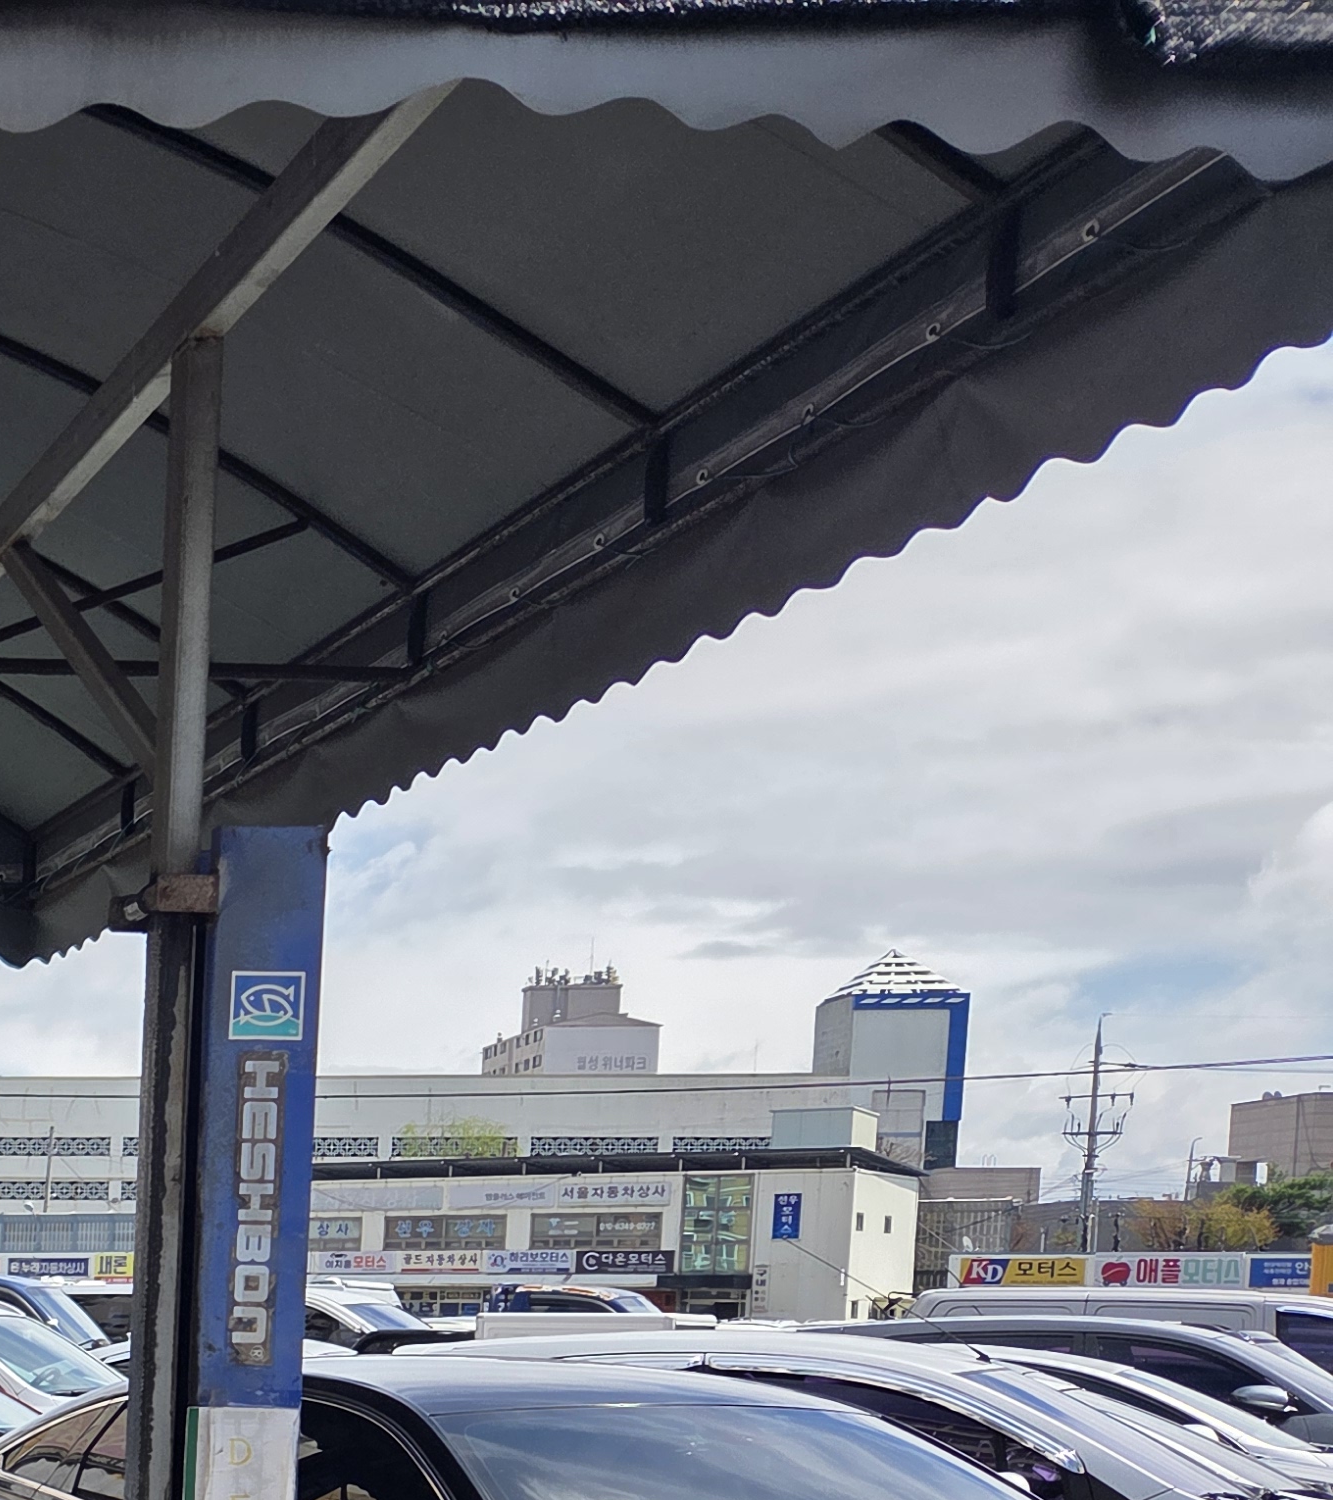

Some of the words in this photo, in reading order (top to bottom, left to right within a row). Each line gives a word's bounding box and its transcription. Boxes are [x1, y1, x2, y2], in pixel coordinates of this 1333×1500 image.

[562, 1185, 666, 1199] 서울자동차상사
[354, 1255, 387, 1269] 모터스
[601, 1253, 667, 1266] 다온모터스
[969, 1260, 1004, 1283] KD
[1015, 1260, 1077, 1279] 모터스
